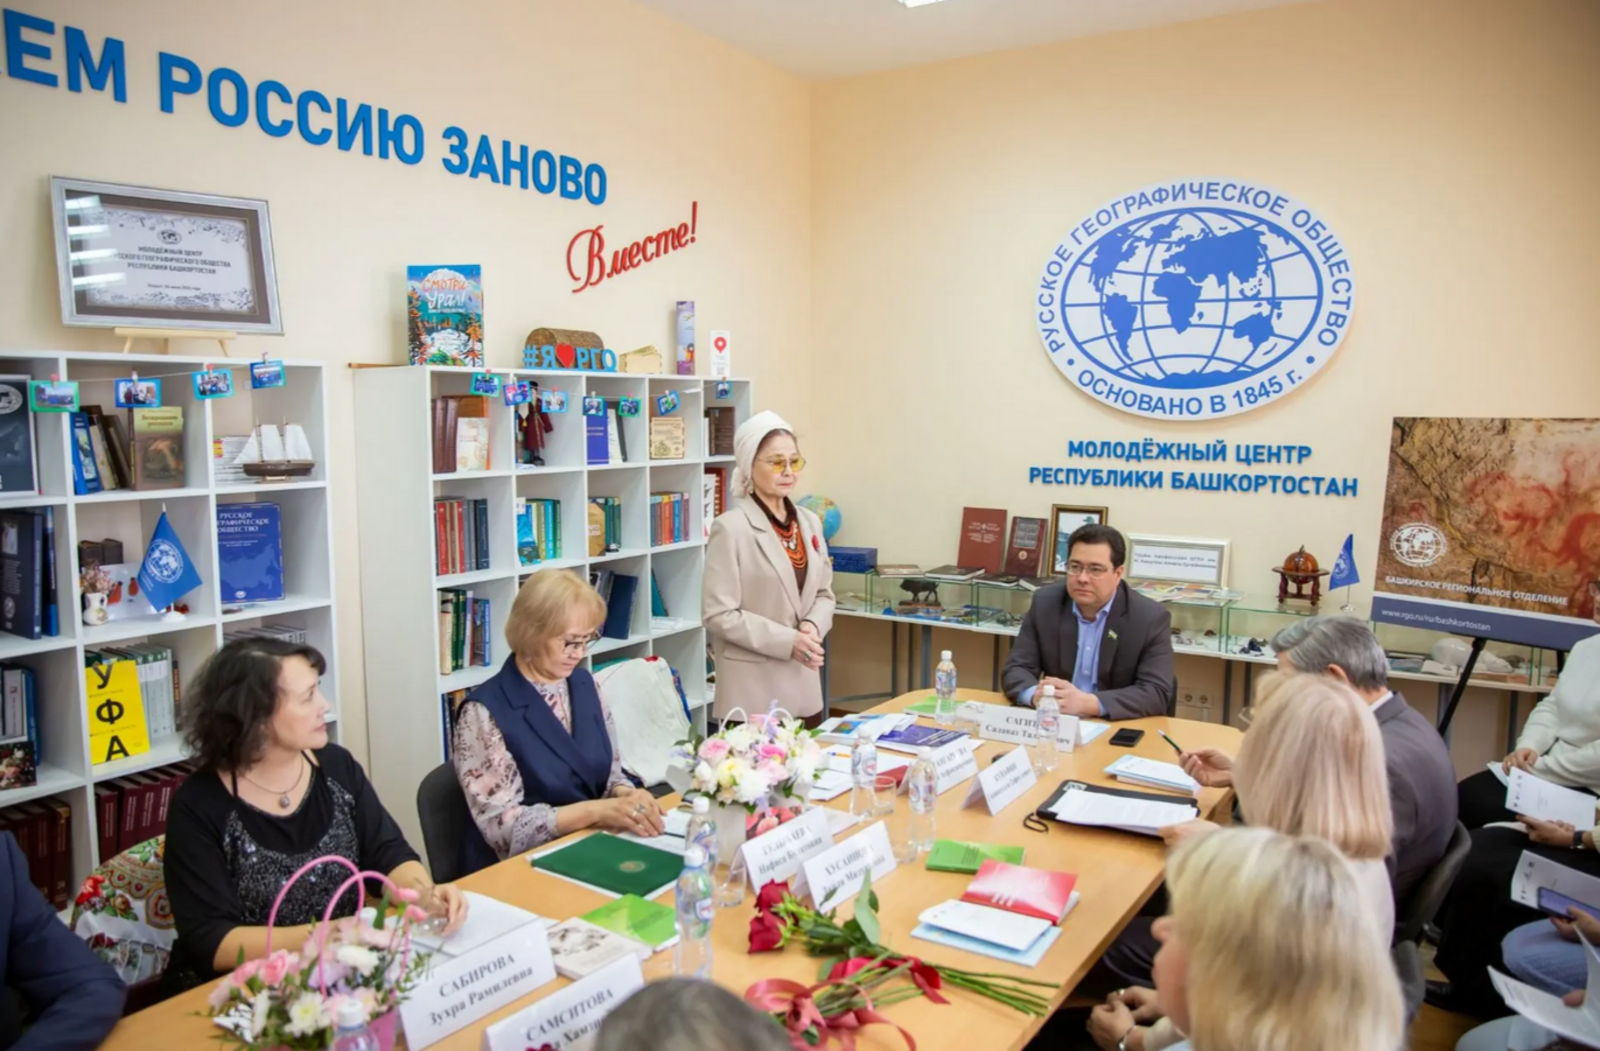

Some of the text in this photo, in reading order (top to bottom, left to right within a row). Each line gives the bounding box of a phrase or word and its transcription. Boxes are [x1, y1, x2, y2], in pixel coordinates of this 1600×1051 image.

[3, 8, 607, 205] ЕМ РОССИЮ ЗАНОВО
[567, 201, 698, 293] Вместе!
[1038, 182, 1352, 353] РУССКОЕ ГЕОГРАФИЧЕСКОЕ ОБЩЕСТВО
[425, 291, 466, 309] Урал!
[575, 346, 617, 372] РГО
[1077, 368, 1304, 416] ОСНОВАНО В 1845 г.
[1068, 438, 1312, 466] МОЛОДЁЖНЫЙ ЦЕНТР
[1029, 467, 1358, 497] РЕСПУБЛИКИ БАШКОРТОСТАН
[1385, 575, 1568, 606] БАШКИРСКОЕ РЕГИОНАЛЬНОЕ ОТДЕЛЕНИЕ
[1381, 608, 1492, 632] www.rgo.ru/ru/bashkortostan
[986, 724, 1019, 737] Салават
[1005, 716, 1038, 729] САГИТ
[787, 837, 823, 860] Буатовна
[439, 953, 516, 999] САБИРОВА
[429, 967, 533, 1027] Зухра Рамилевна
[526, 988, 614, 1042] САМСИТОВА
